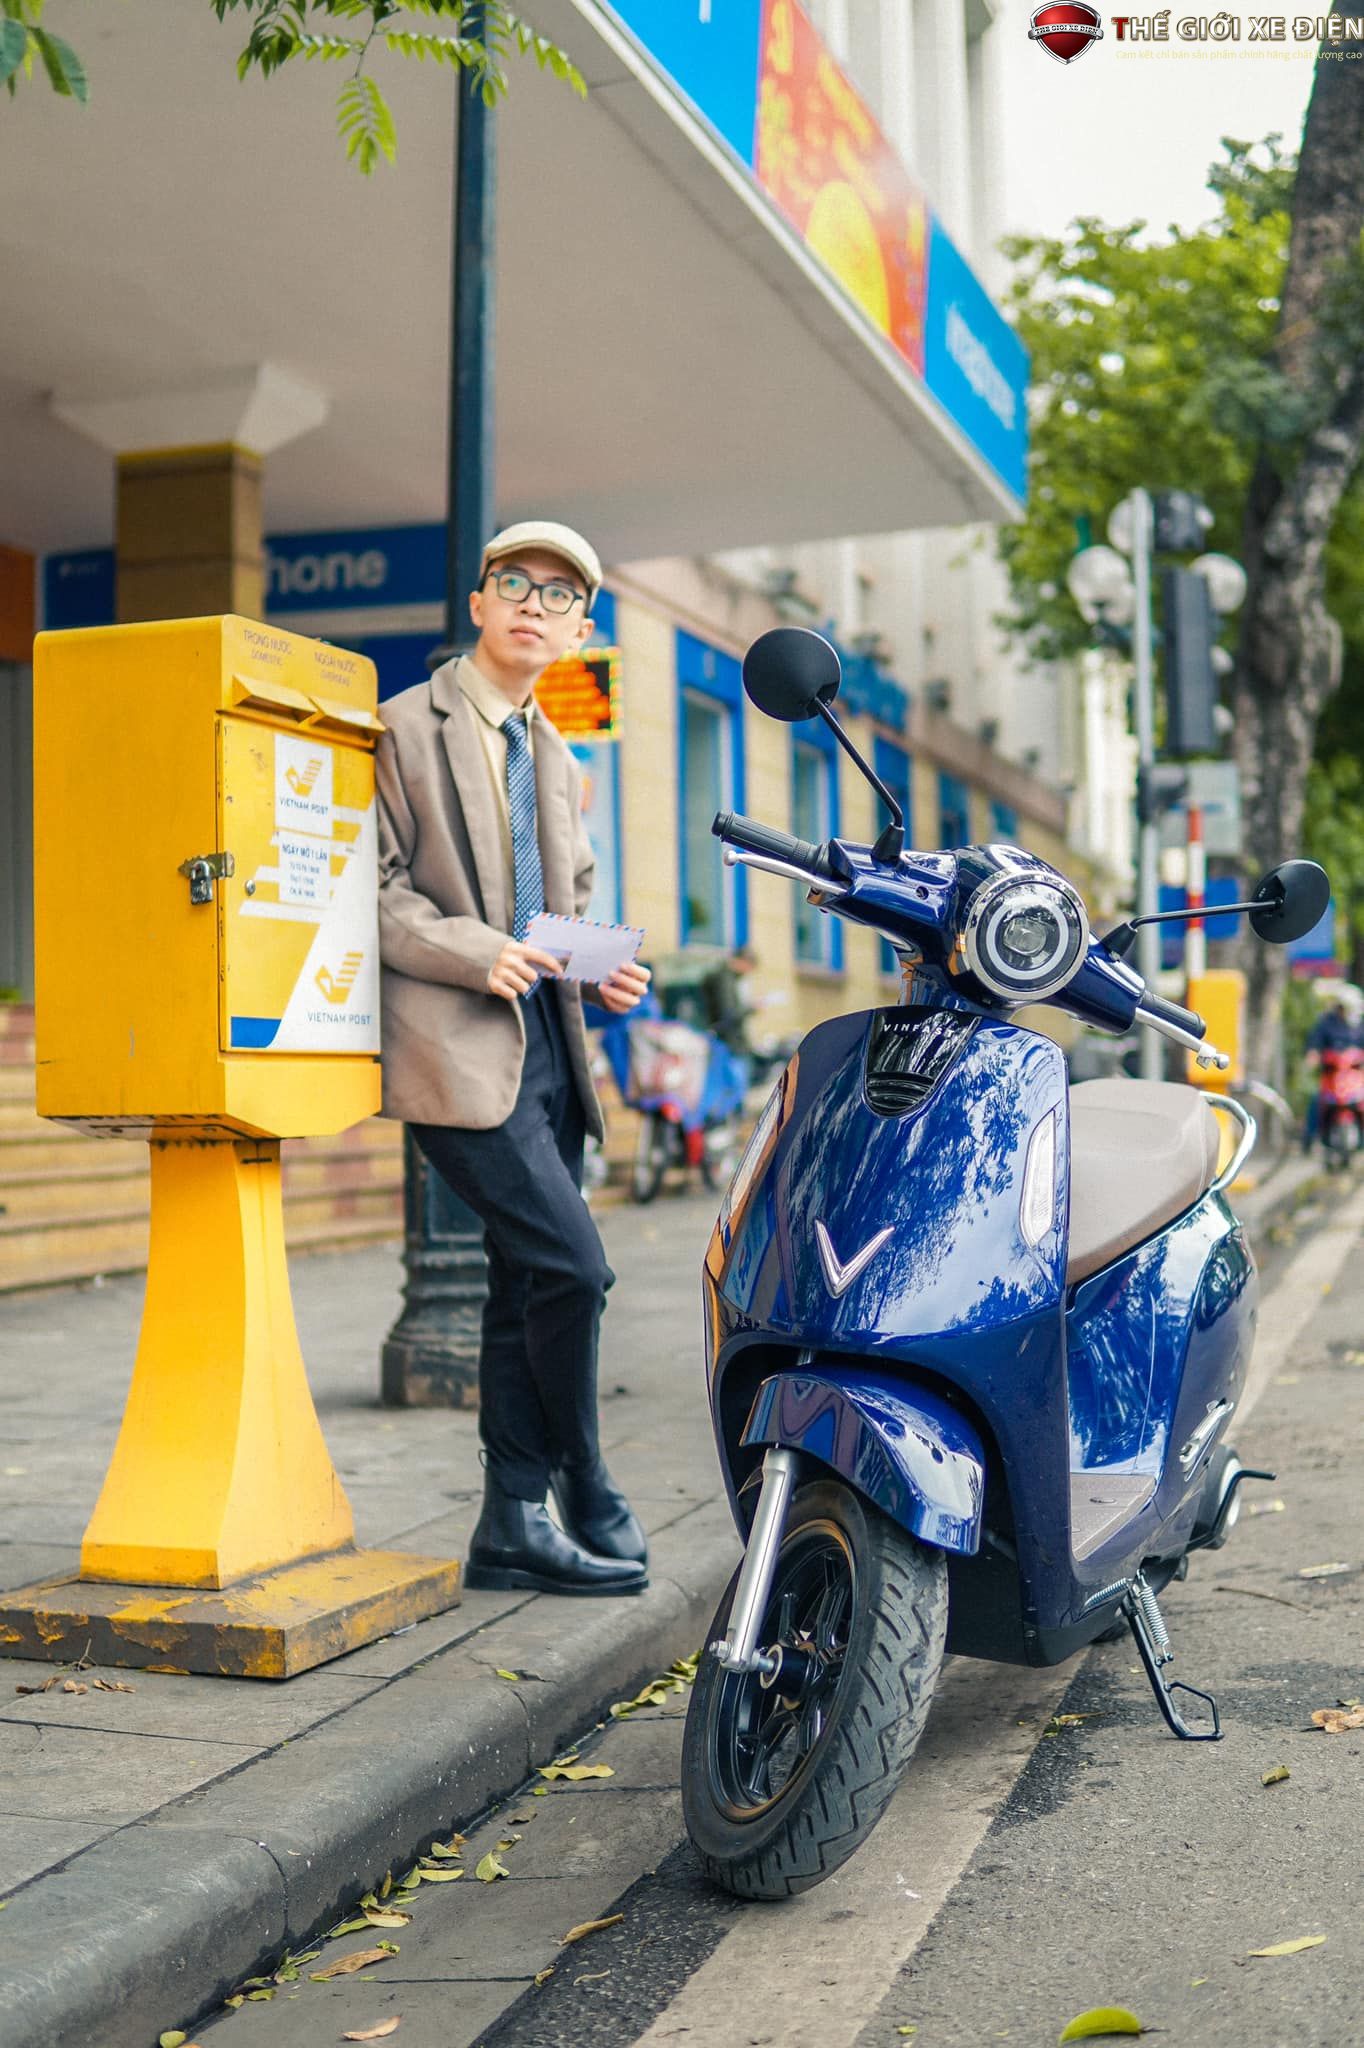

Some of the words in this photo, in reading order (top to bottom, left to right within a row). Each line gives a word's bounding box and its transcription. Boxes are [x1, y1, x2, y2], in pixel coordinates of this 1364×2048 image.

[280, 797, 309, 811] VIETNAM
[310, 803, 329, 816] POST
[307, 1011, 347, 1024] VIETNAM
[350, 1013, 371, 1026] POST
[883, 1023, 955, 1037] VINFAST
